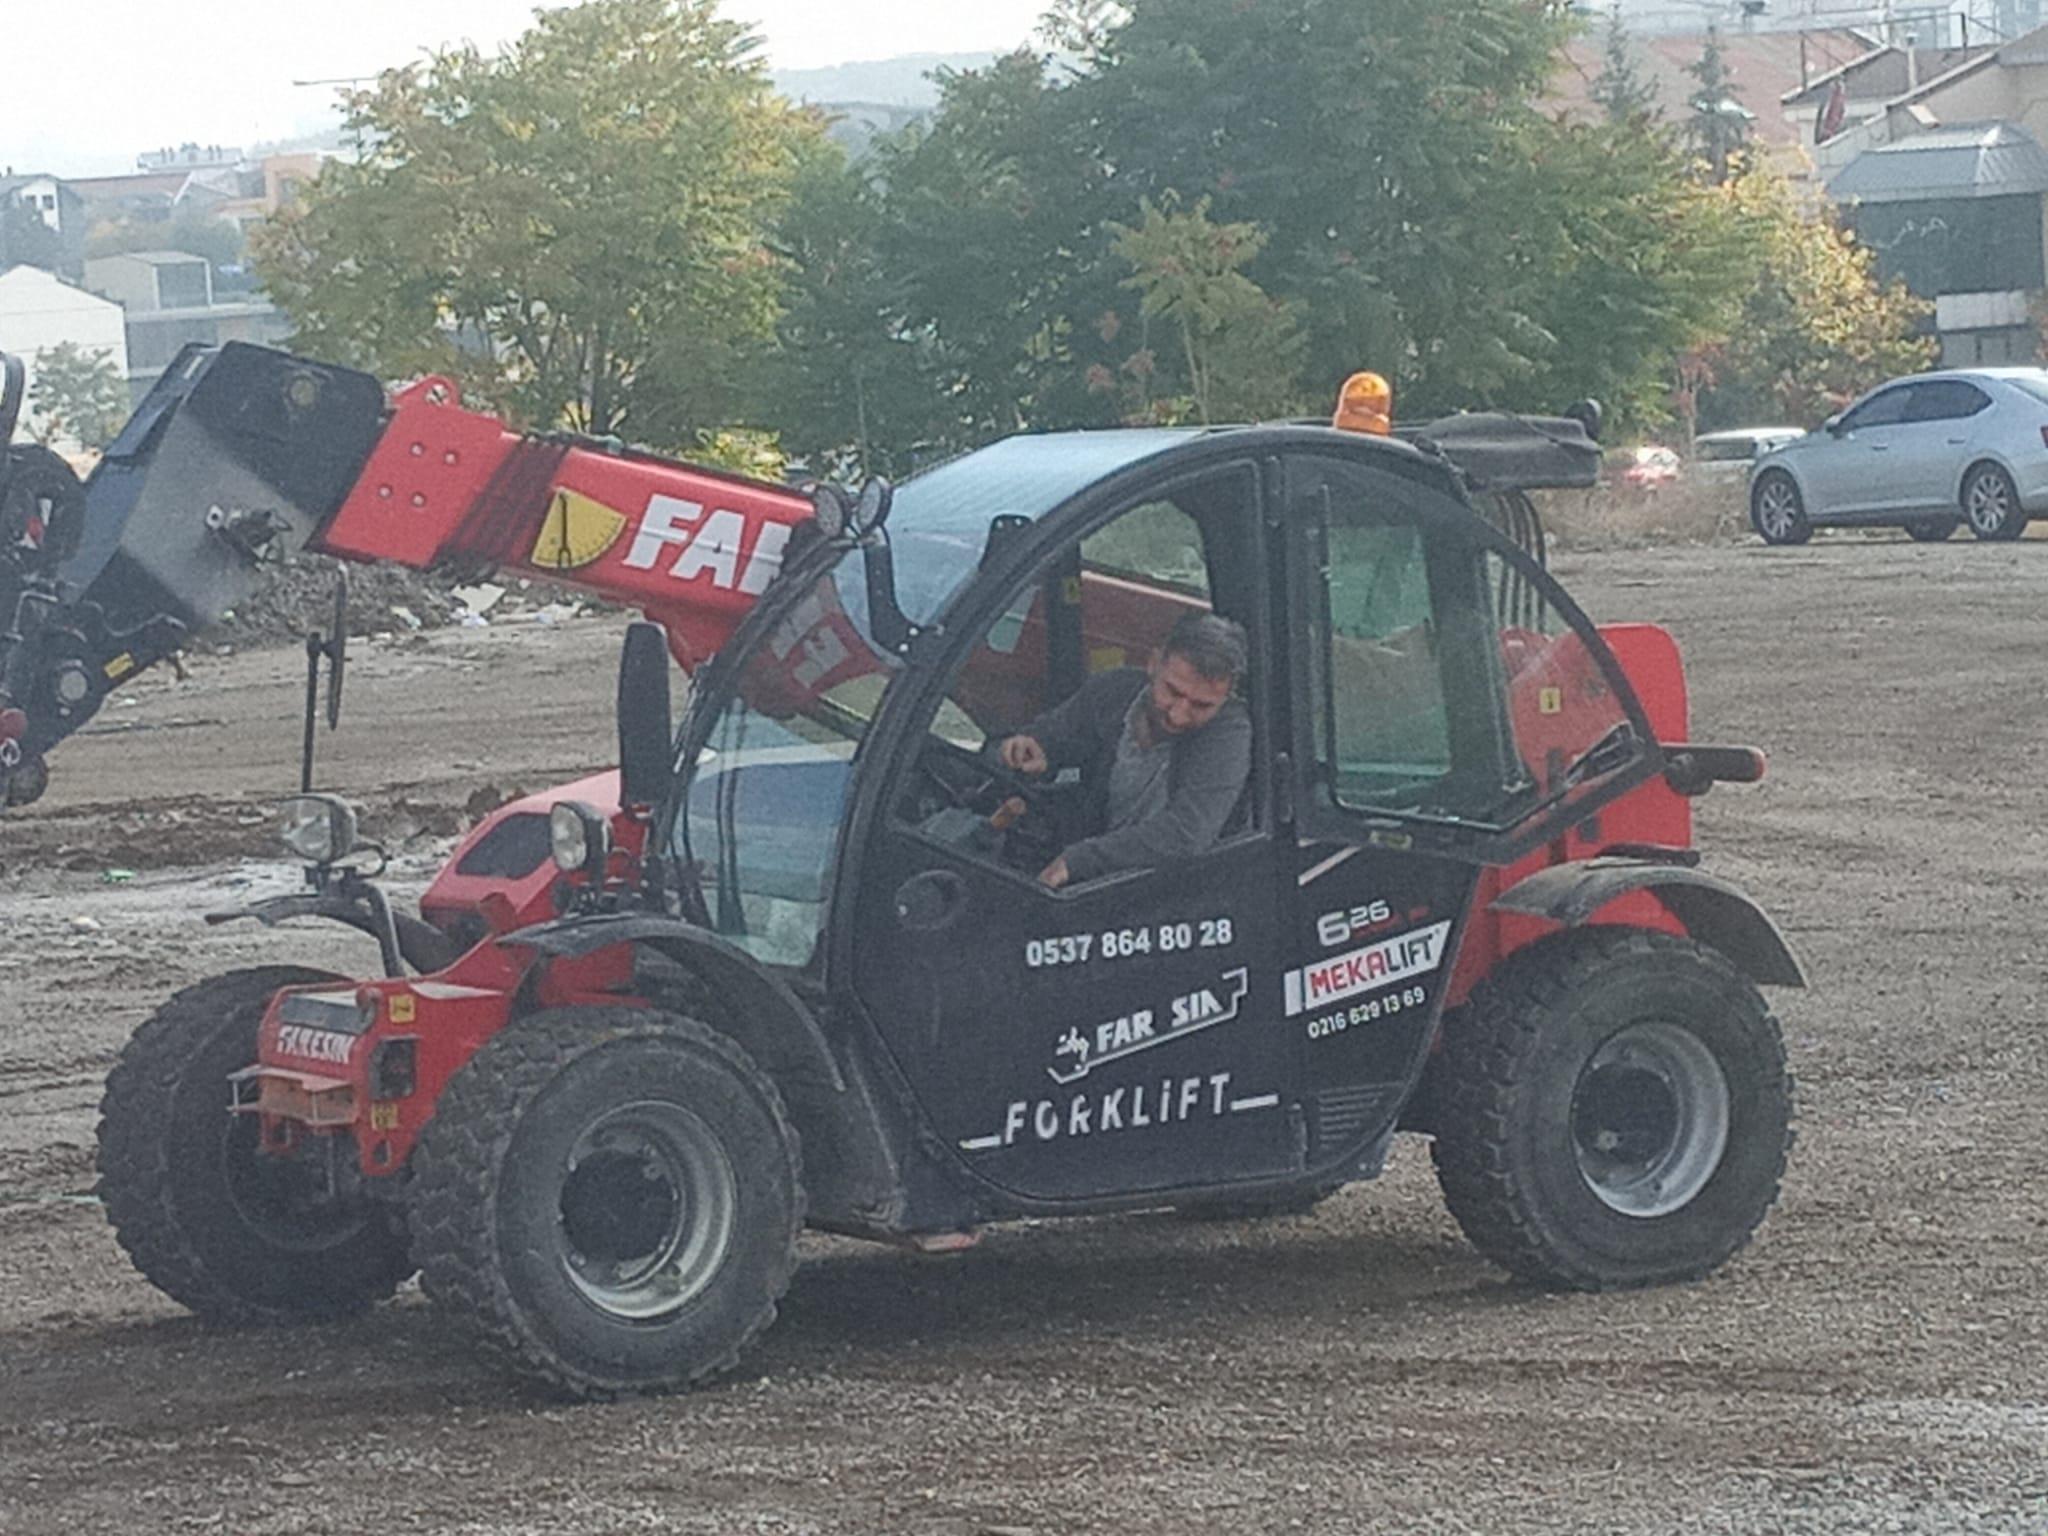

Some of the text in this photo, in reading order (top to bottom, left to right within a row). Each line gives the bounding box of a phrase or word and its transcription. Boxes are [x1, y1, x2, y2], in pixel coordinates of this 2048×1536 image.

[1026, 918, 1233, 967] 0537 864 80 28
[1317, 900, 1390, 946] 626
[1309, 933, 1433, 999] MEKALIFT
[1308, 1012, 1347, 1039] 0216
[1383, 995, 1401, 1013] 13
[1404, 986, 1425, 1007] 69
